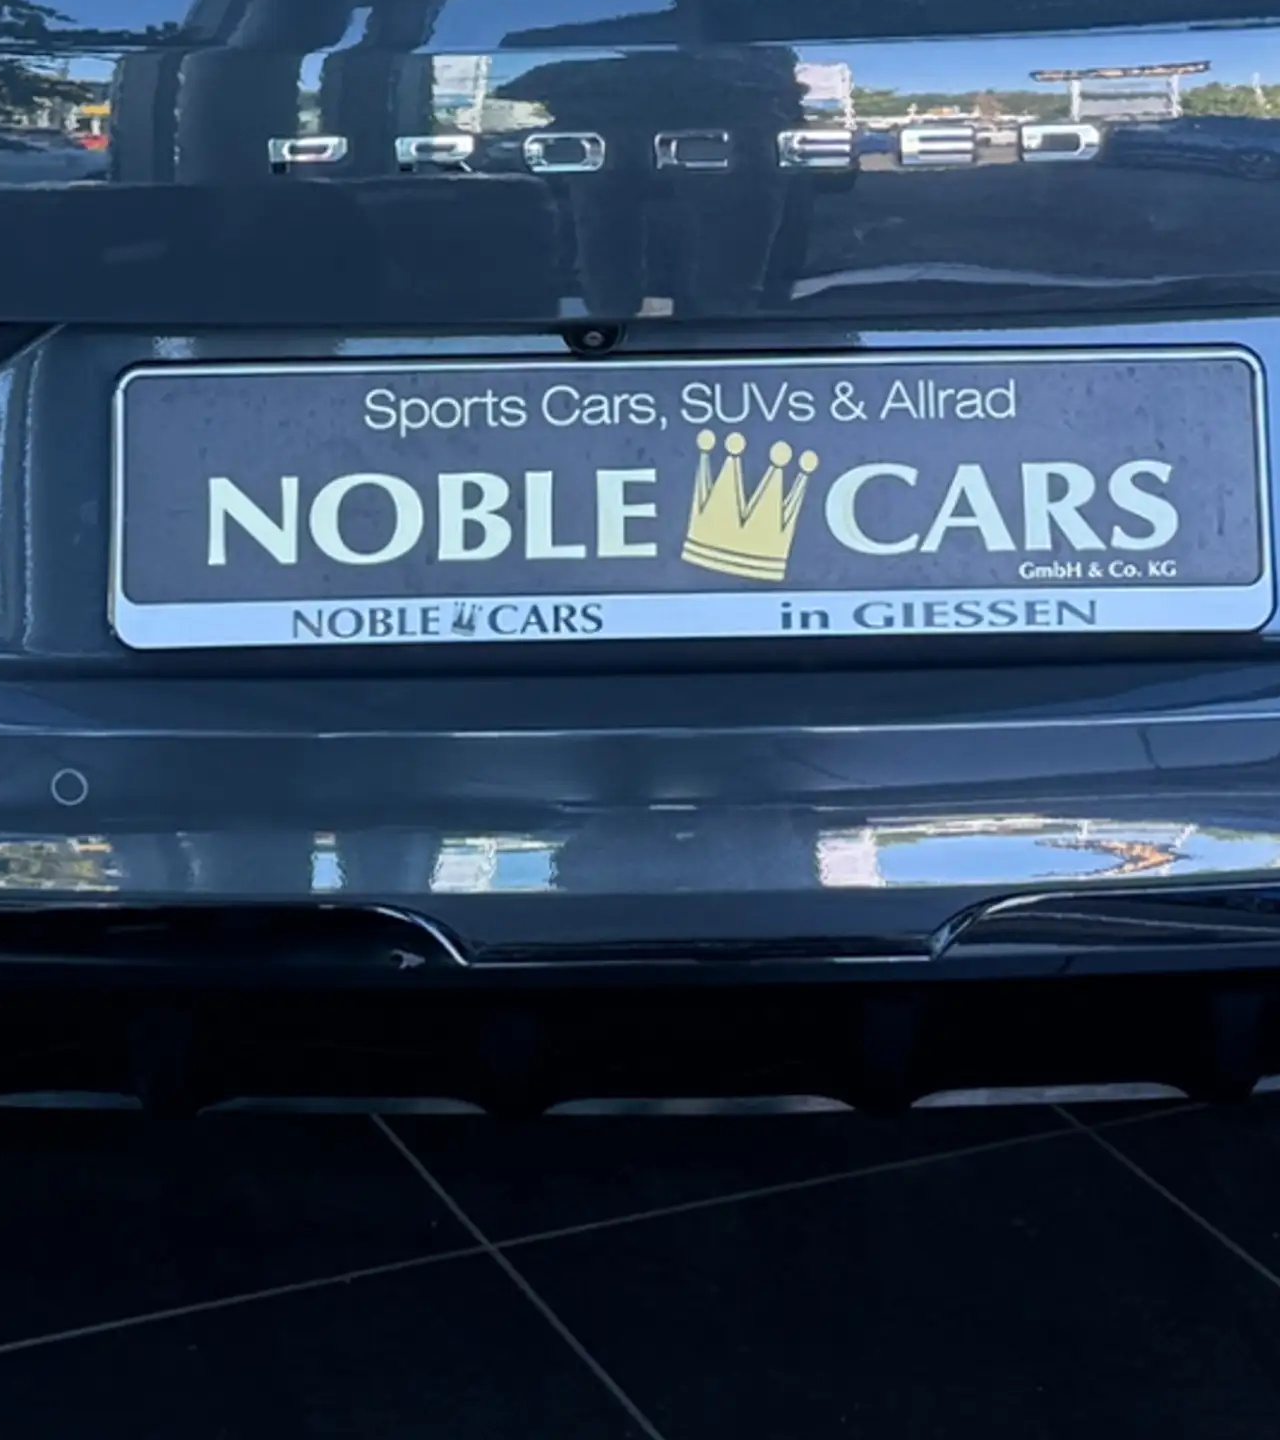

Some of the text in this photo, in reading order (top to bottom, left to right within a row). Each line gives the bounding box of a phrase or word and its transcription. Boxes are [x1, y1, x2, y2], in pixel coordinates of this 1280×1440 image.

[268, 122, 1101, 174] PROCEED
[364, 378, 1017, 438] Sports Cars, SUVs & Allrad
[207, 459, 1180, 566] NOBLE CARS
[1018, 559, 1177, 580] GmbH & Co. KG
[292, 602, 604, 639] NOBLE CARS
[780, 599, 1098, 630] in GIESSEN
